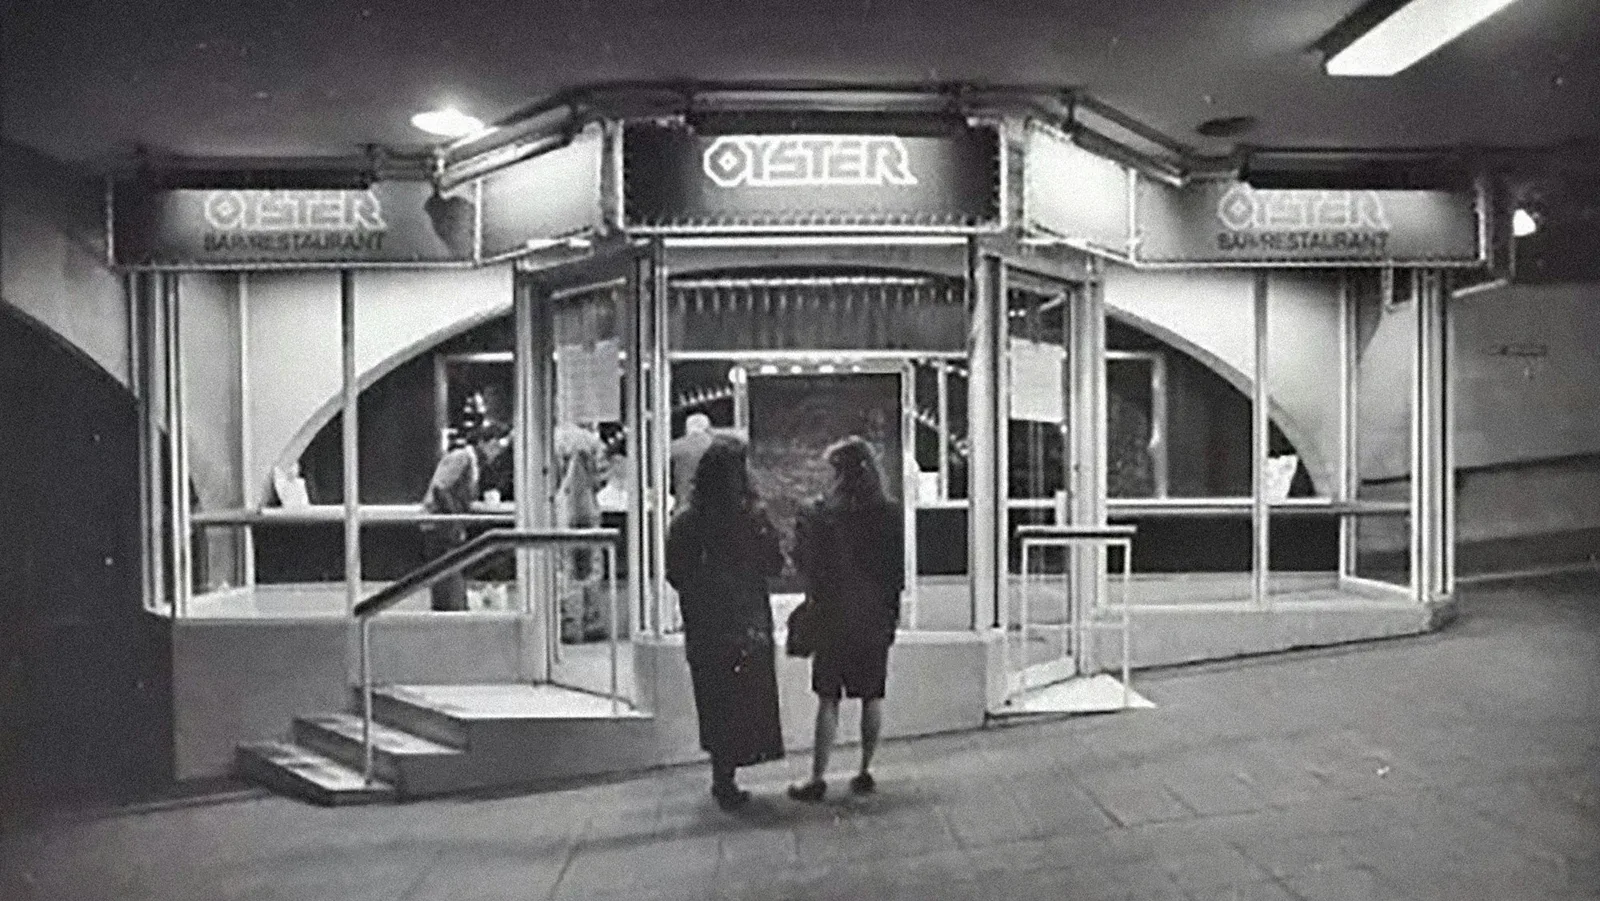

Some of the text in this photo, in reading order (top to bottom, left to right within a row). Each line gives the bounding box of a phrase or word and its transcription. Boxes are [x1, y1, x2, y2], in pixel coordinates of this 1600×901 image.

[703, 134, 918, 187] OYSTER
[204, 188, 388, 231] OYSTER
[1217, 182, 1390, 231] OYSTER
